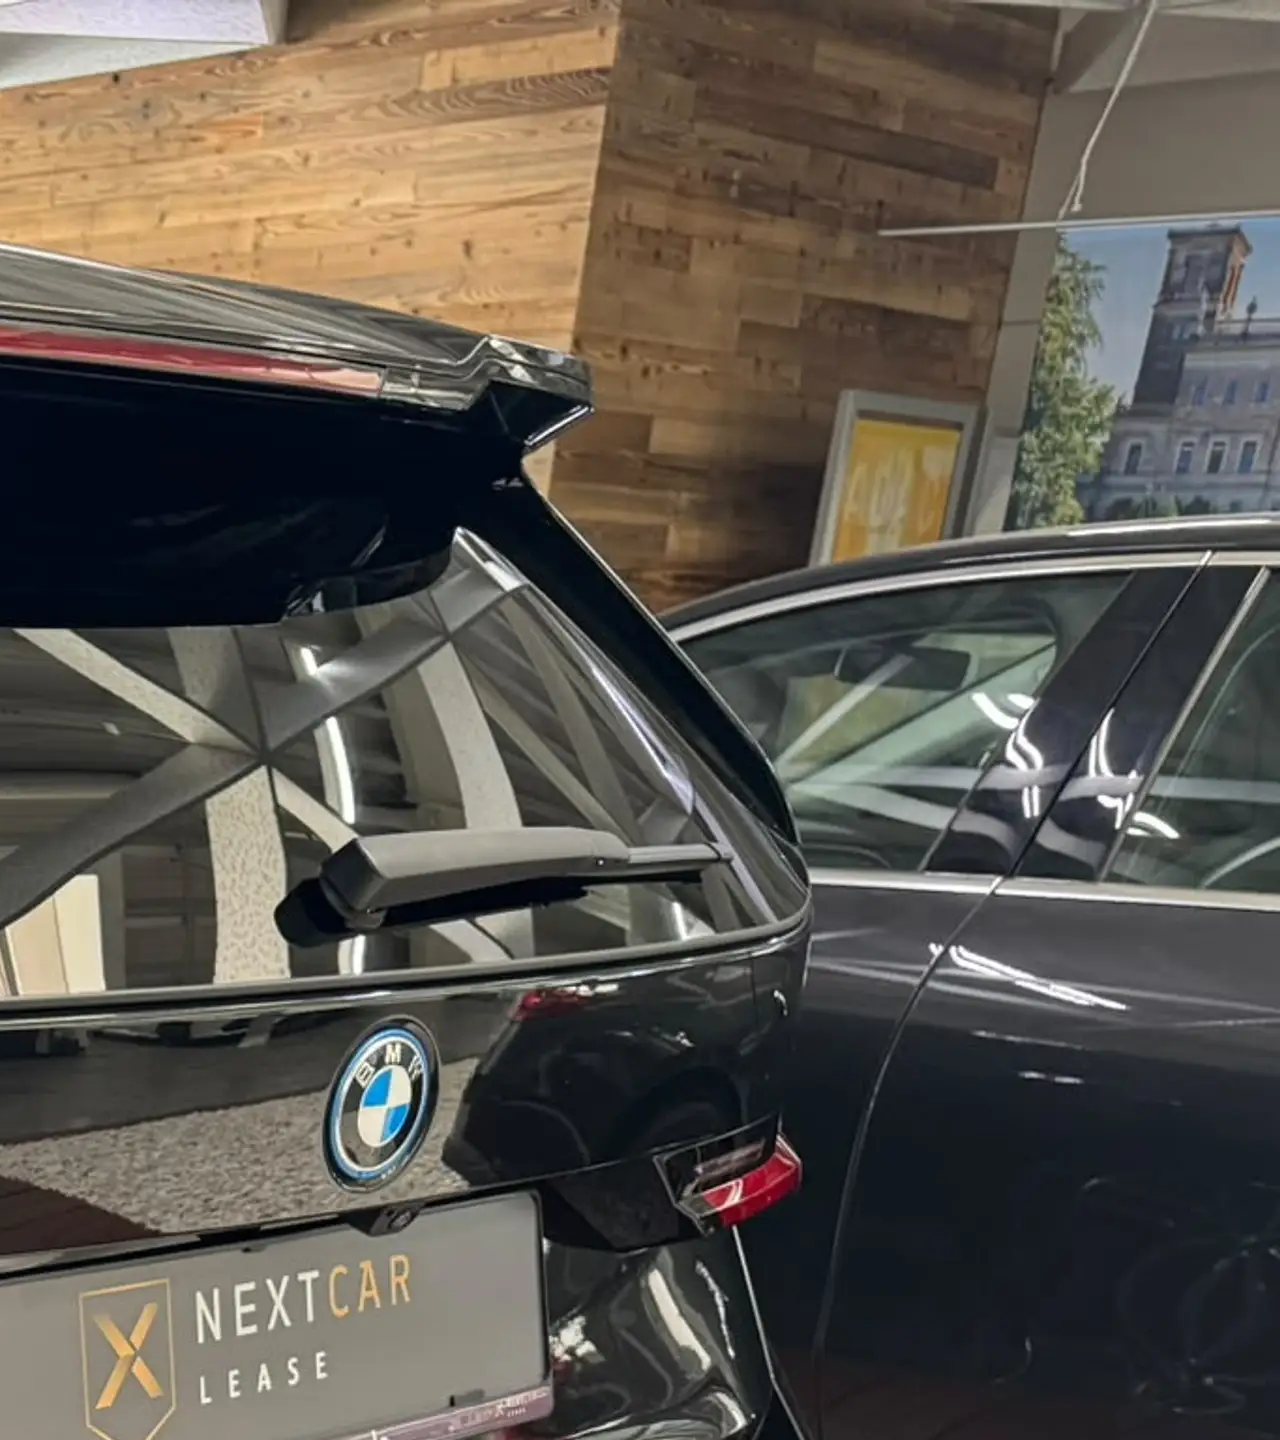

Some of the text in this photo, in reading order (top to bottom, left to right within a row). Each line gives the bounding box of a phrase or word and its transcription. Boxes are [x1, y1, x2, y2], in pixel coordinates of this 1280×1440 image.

[355, 1042, 424, 1088] BMW
[195, 1254, 412, 1344] NEXTCAR
[199, 1351, 328, 1404] LEASE
